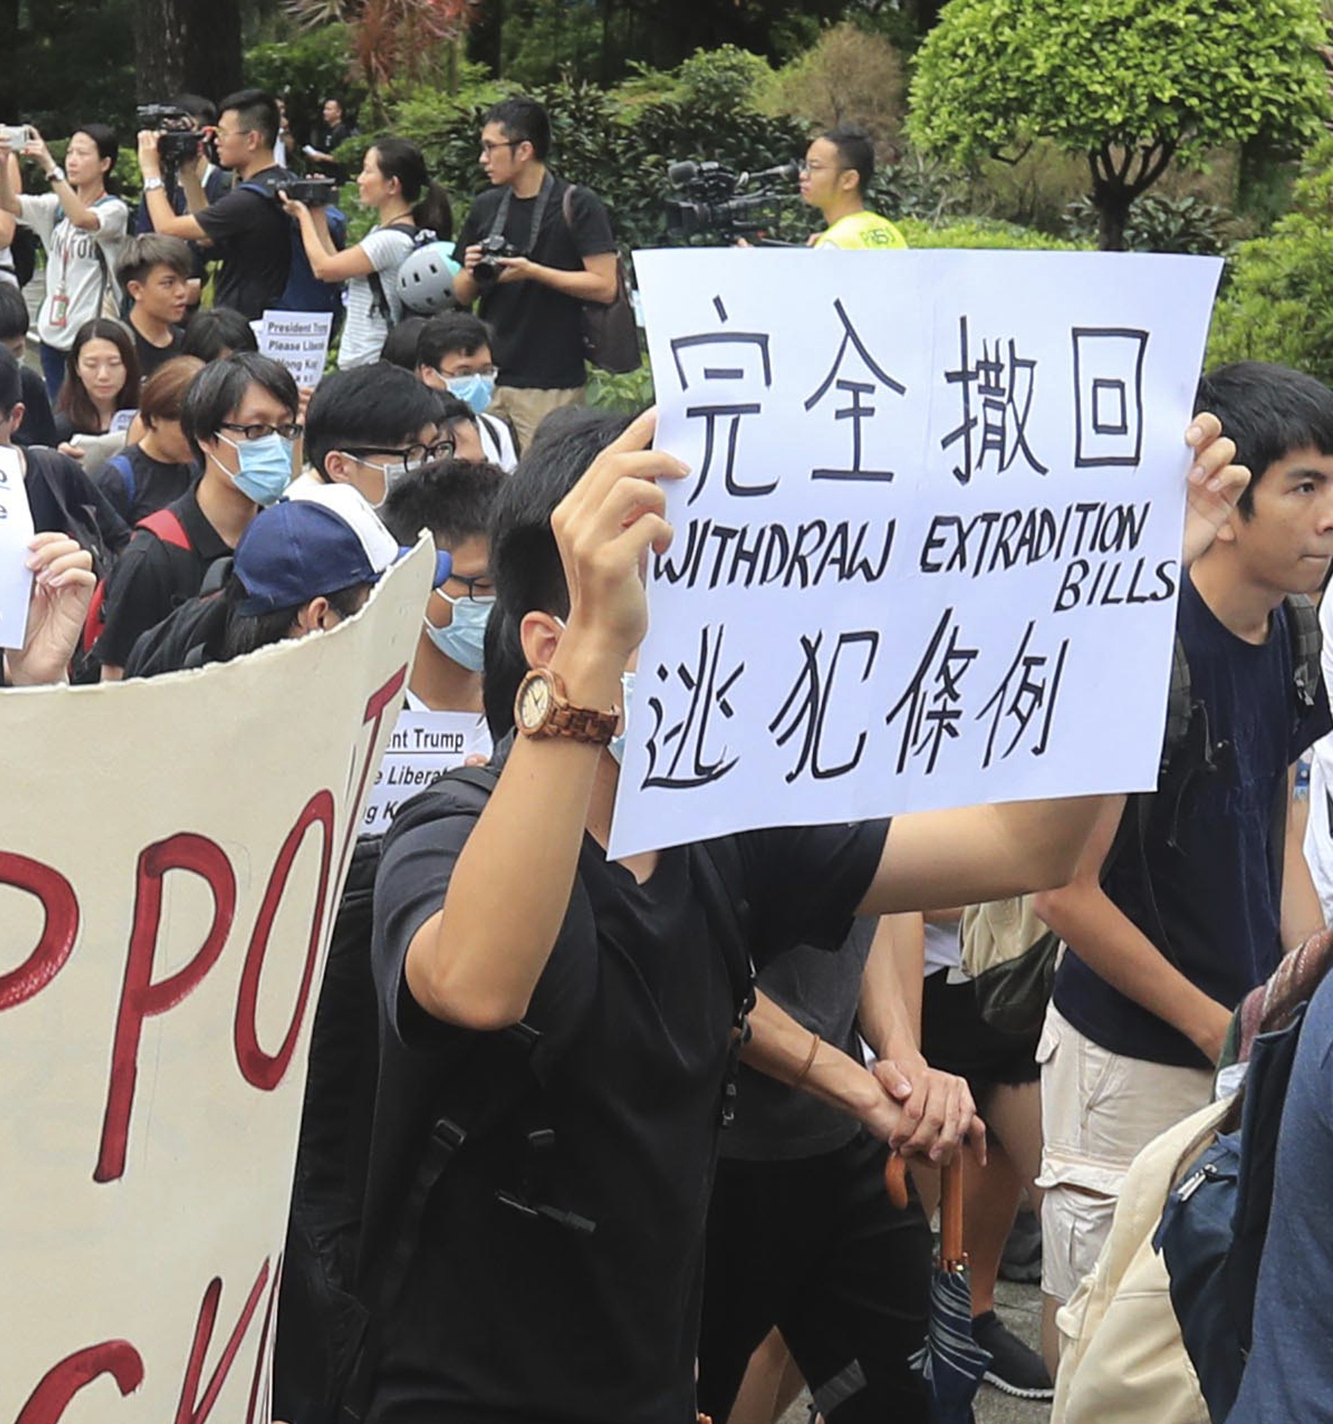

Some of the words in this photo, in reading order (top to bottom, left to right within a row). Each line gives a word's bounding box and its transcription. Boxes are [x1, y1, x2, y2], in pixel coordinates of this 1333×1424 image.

[653, 517, 896, 590] WITHDRAW
[919, 501, 1151, 578] EXTRADITION
[1053, 556, 1178, 613] BILLS
[640, 607, 1070, 791] 逃犯條例
[414, 728, 464, 753] Trump
